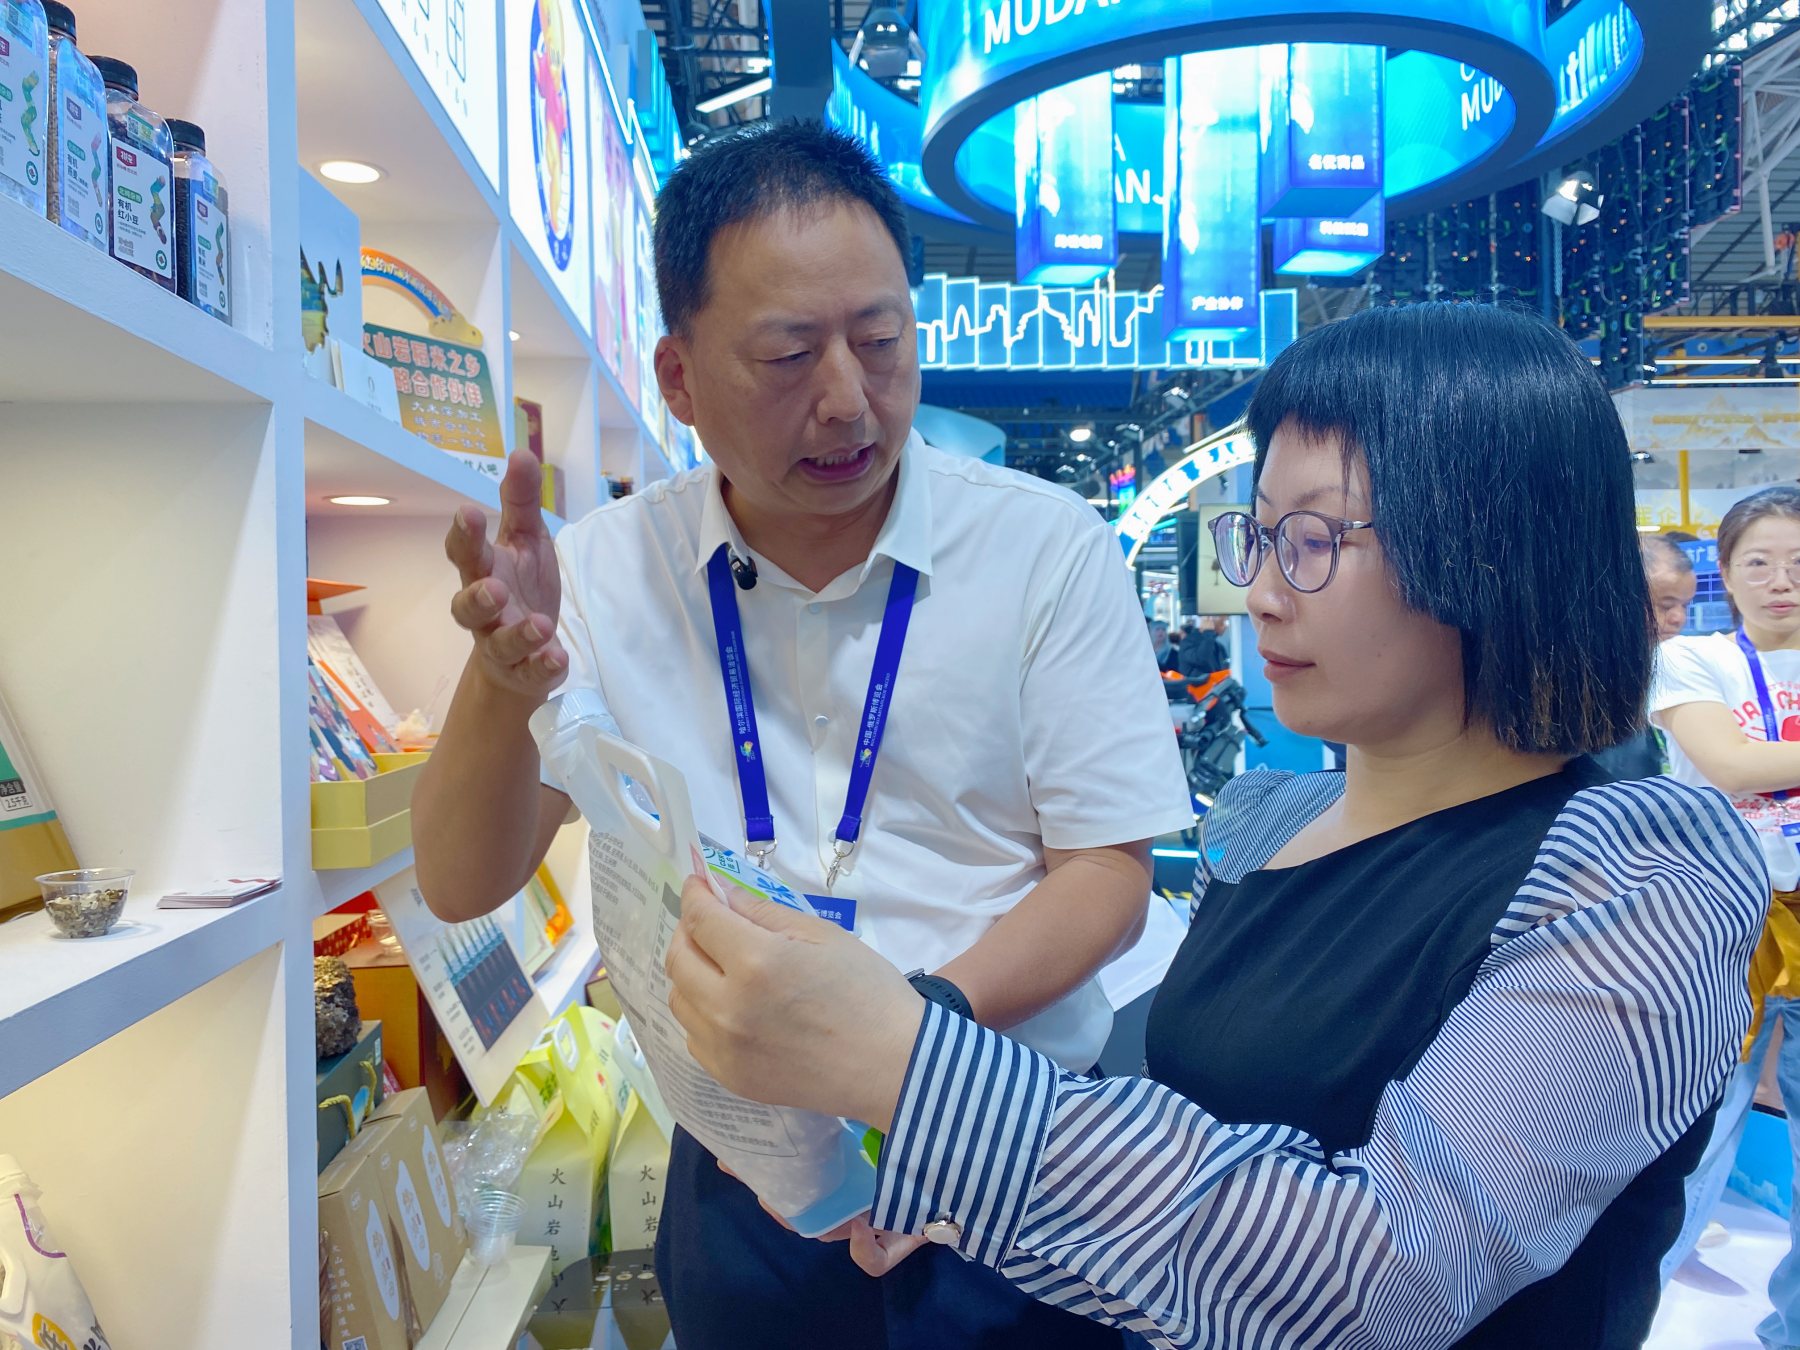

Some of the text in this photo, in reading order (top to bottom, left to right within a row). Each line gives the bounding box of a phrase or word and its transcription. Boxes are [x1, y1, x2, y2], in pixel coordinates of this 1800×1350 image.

[983, 0, 1122, 54] MUD
[117, 199, 133, 213] 有机
[117, 209, 140, 226] 红小豆
[724, 645, 747, 734] 哈尔滨国际经济贸易洽谈会
